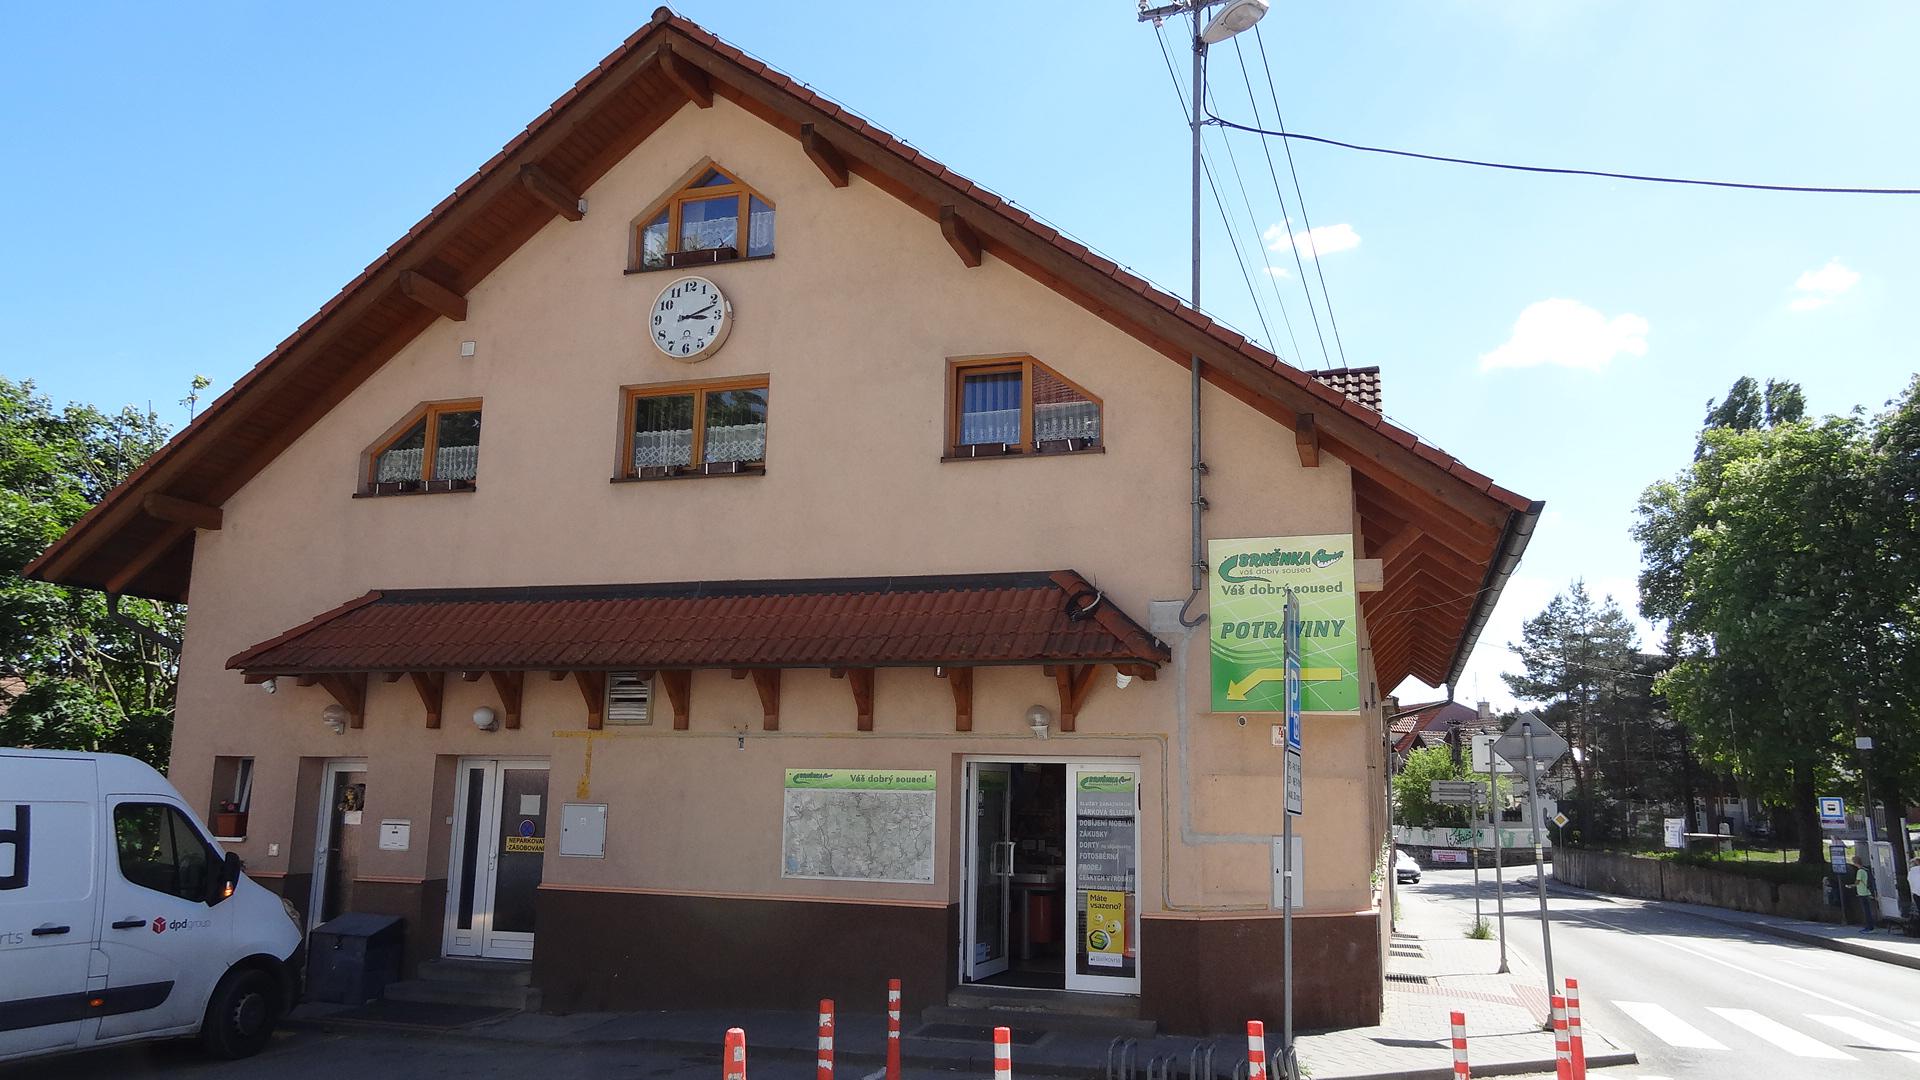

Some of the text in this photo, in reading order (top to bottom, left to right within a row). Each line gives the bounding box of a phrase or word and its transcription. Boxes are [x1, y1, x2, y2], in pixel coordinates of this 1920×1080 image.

[684, 281, 698, 292] 12
[702, 284, 707, 294] 1
[671, 287, 681, 298] 11
[710, 294, 718, 304] 2
[660, 300, 674, 310] 10
[714, 310, 722, 320] 3
[654, 315, 662, 326] 9
[658, 330, 666, 340] 8
[707, 325, 716, 335] 4
[668, 340, 675, 351] 7
[697, 338, 704, 348] 5
[682, 343, 689, 354] 6
[1238, 548, 1311, 567] BRNĚNKA
[1222, 582, 1342, 597] Váš dobrý soused
[850, 774, 865, 783] Váš
[868, 775, 893, 785] dobrý
[1079, 829, 1108, 837] ZÁKUSKY
